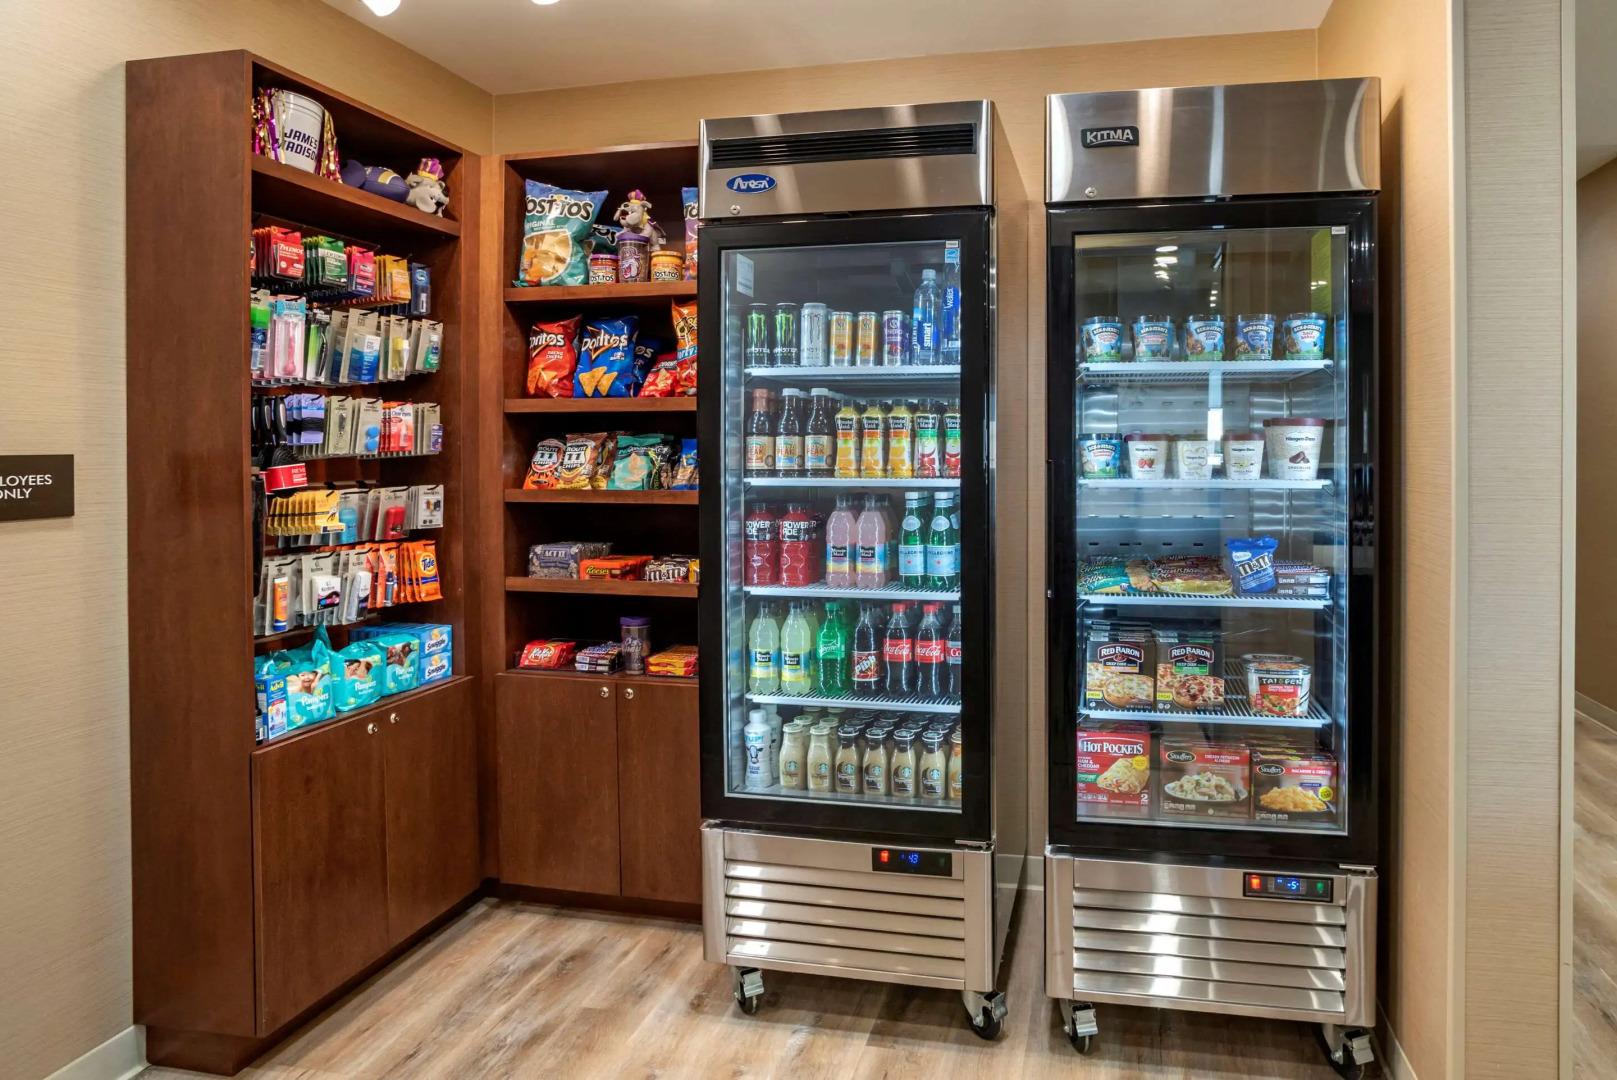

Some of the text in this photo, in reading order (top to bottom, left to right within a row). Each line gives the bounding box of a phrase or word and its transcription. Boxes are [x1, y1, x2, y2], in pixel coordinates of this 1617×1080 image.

[284, 128, 318, 150] JAMES
[1087, 129, 1133, 143] KITMA
[582, 329, 628, 351] Doritos
[923, 323, 931, 348] smart
[783, 521, 809, 529] POWER
[421, 558, 435, 571] Tide
[586, 566, 610, 574] Reese's
[427, 638, 446, 651] Snuggle
[1101, 646, 1140, 658] RED BARON
[1172, 647, 1210, 658] RED BARON
[427, 665, 446, 677] Snuggle
[269, 682, 284, 692] Advil
[302, 693, 328, 706] Pampers
[1083, 742, 1143, 754] HOT POCKETS
[1141, 794, 1148, 802] 2
